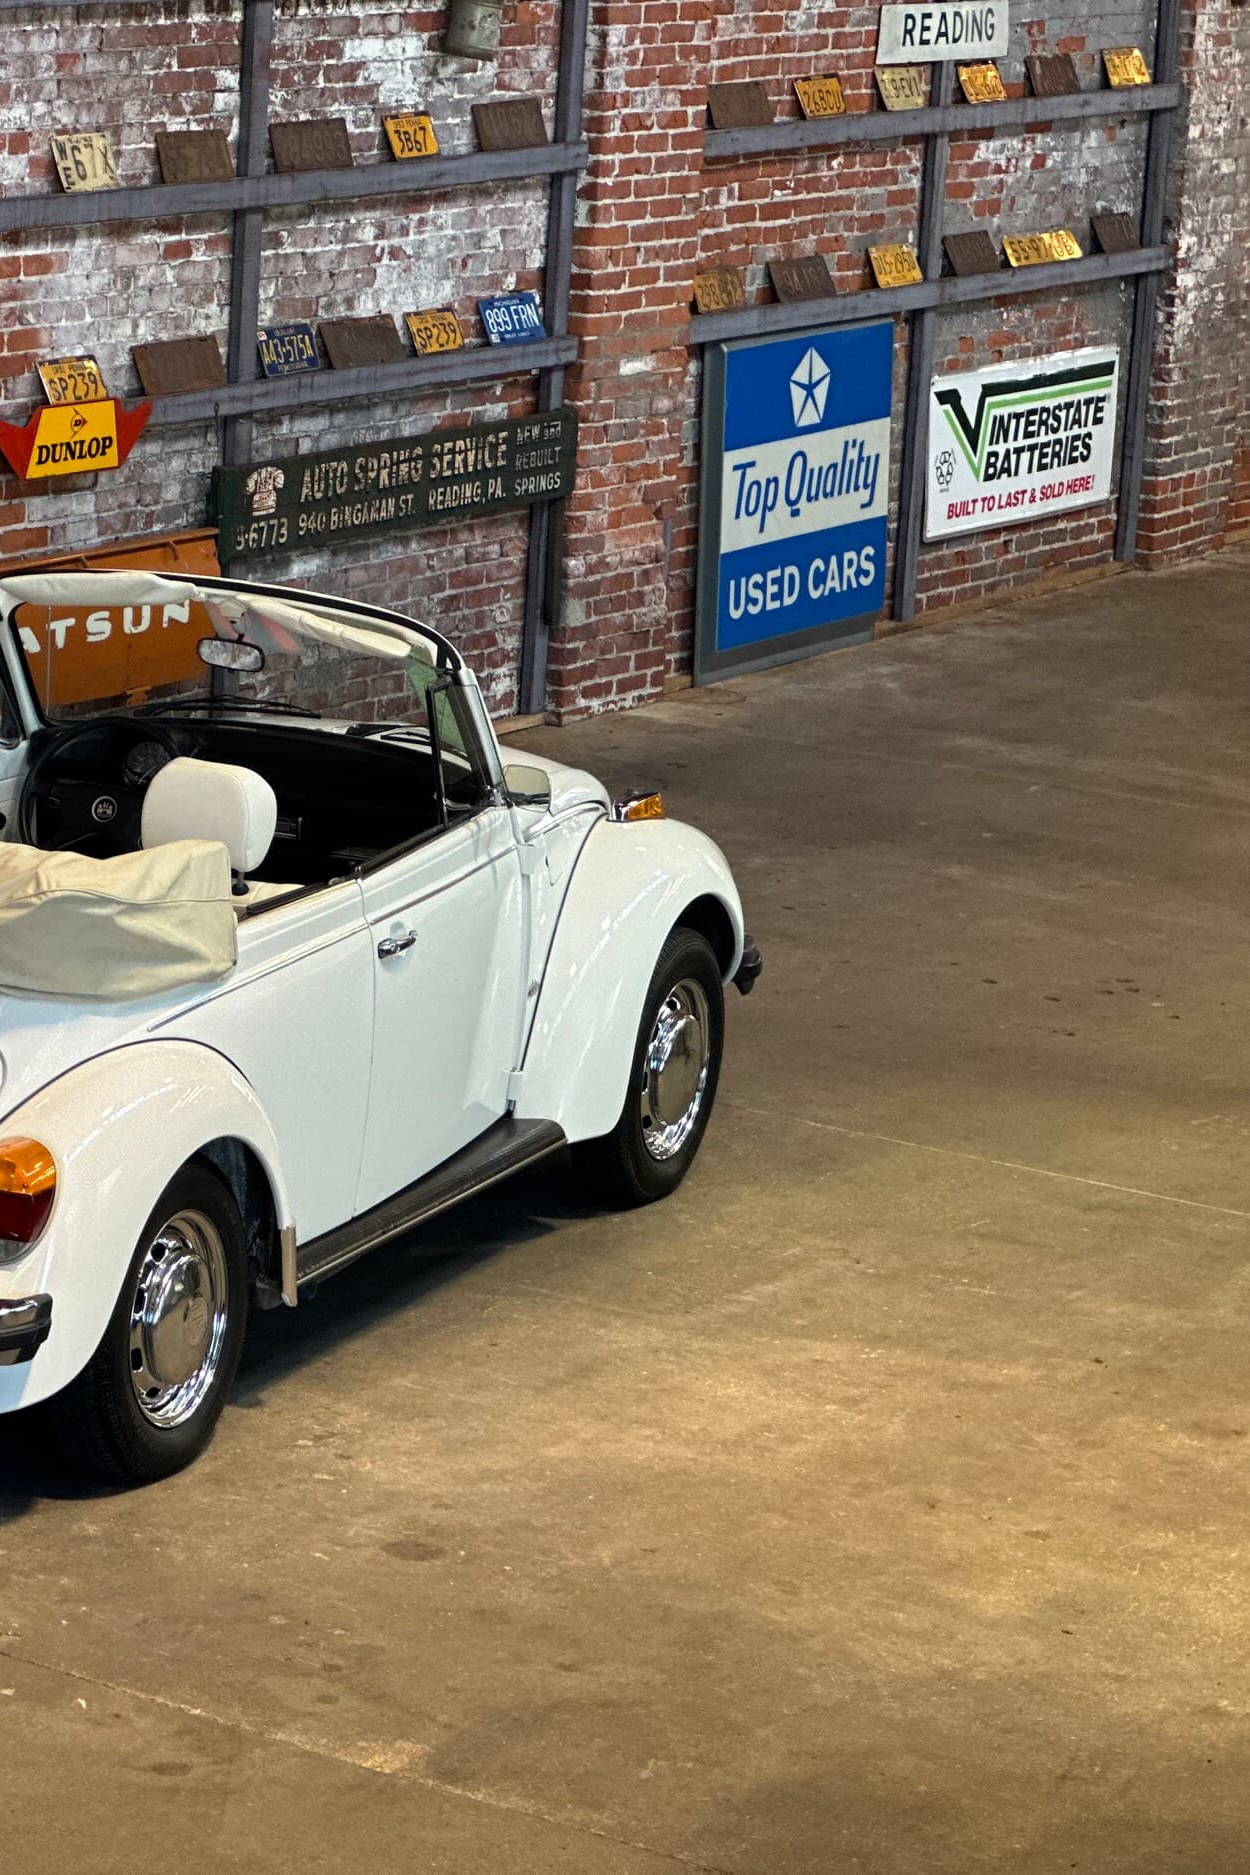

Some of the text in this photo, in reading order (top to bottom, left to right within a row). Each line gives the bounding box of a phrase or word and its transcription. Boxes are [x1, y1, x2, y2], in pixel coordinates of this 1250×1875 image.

[901, 9, 996, 47] READING
[393, 125, 428, 155] 3B67
[485, 302, 540, 333] 899 FRN
[416, 321, 458, 351] SP239
[48, 370, 99, 402] SP239
[516, 423, 541, 445] NEW
[988, 394, 1107, 447] INTERSTATE
[36, 435, 113, 466] DUNLOP
[300, 431, 509, 502] AUTO SPRING SERVICE
[515, 446, 562, 471] REBUILT
[982, 431, 1093, 483] BATTERIES
[514, 471, 561, 497] SPRINGS
[732, 437, 881, 534] Top Quality
[946, 474, 1096, 520] BUILT TO LAST & SOLD HERE!
[298, 511, 326, 536] 940
[330, 497, 395, 531] BINGAMAN
[398, 493, 416, 517] ST.
[487, 476, 506, 500] PA.
[728, 545, 876, 620] USED CARS
